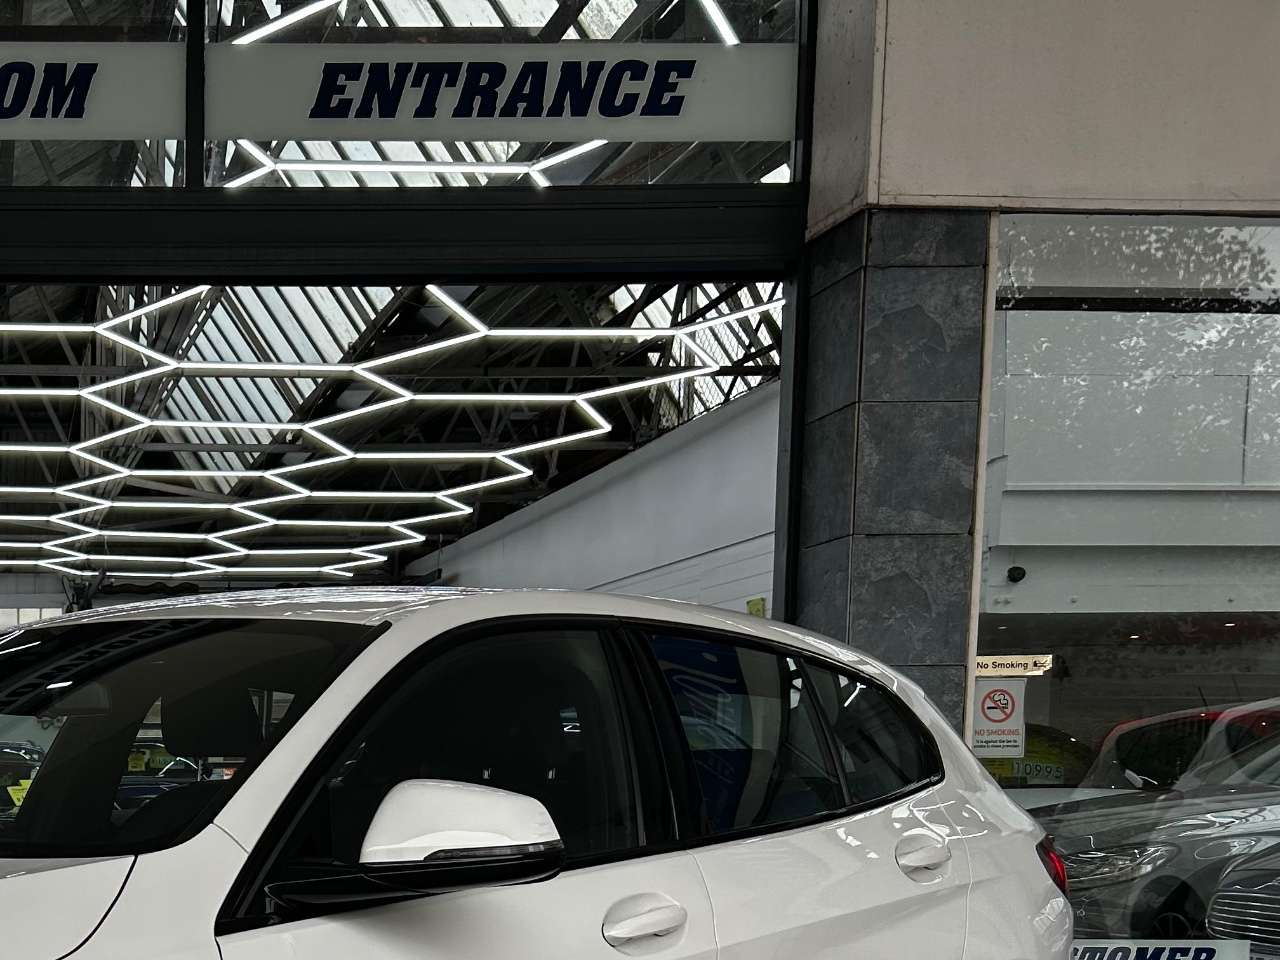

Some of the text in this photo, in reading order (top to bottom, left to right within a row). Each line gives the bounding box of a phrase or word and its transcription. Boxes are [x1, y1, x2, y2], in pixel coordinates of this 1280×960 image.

[308, 59, 697, 119] ENTRANCE
[976, 661, 1029, 670] No Smoking
